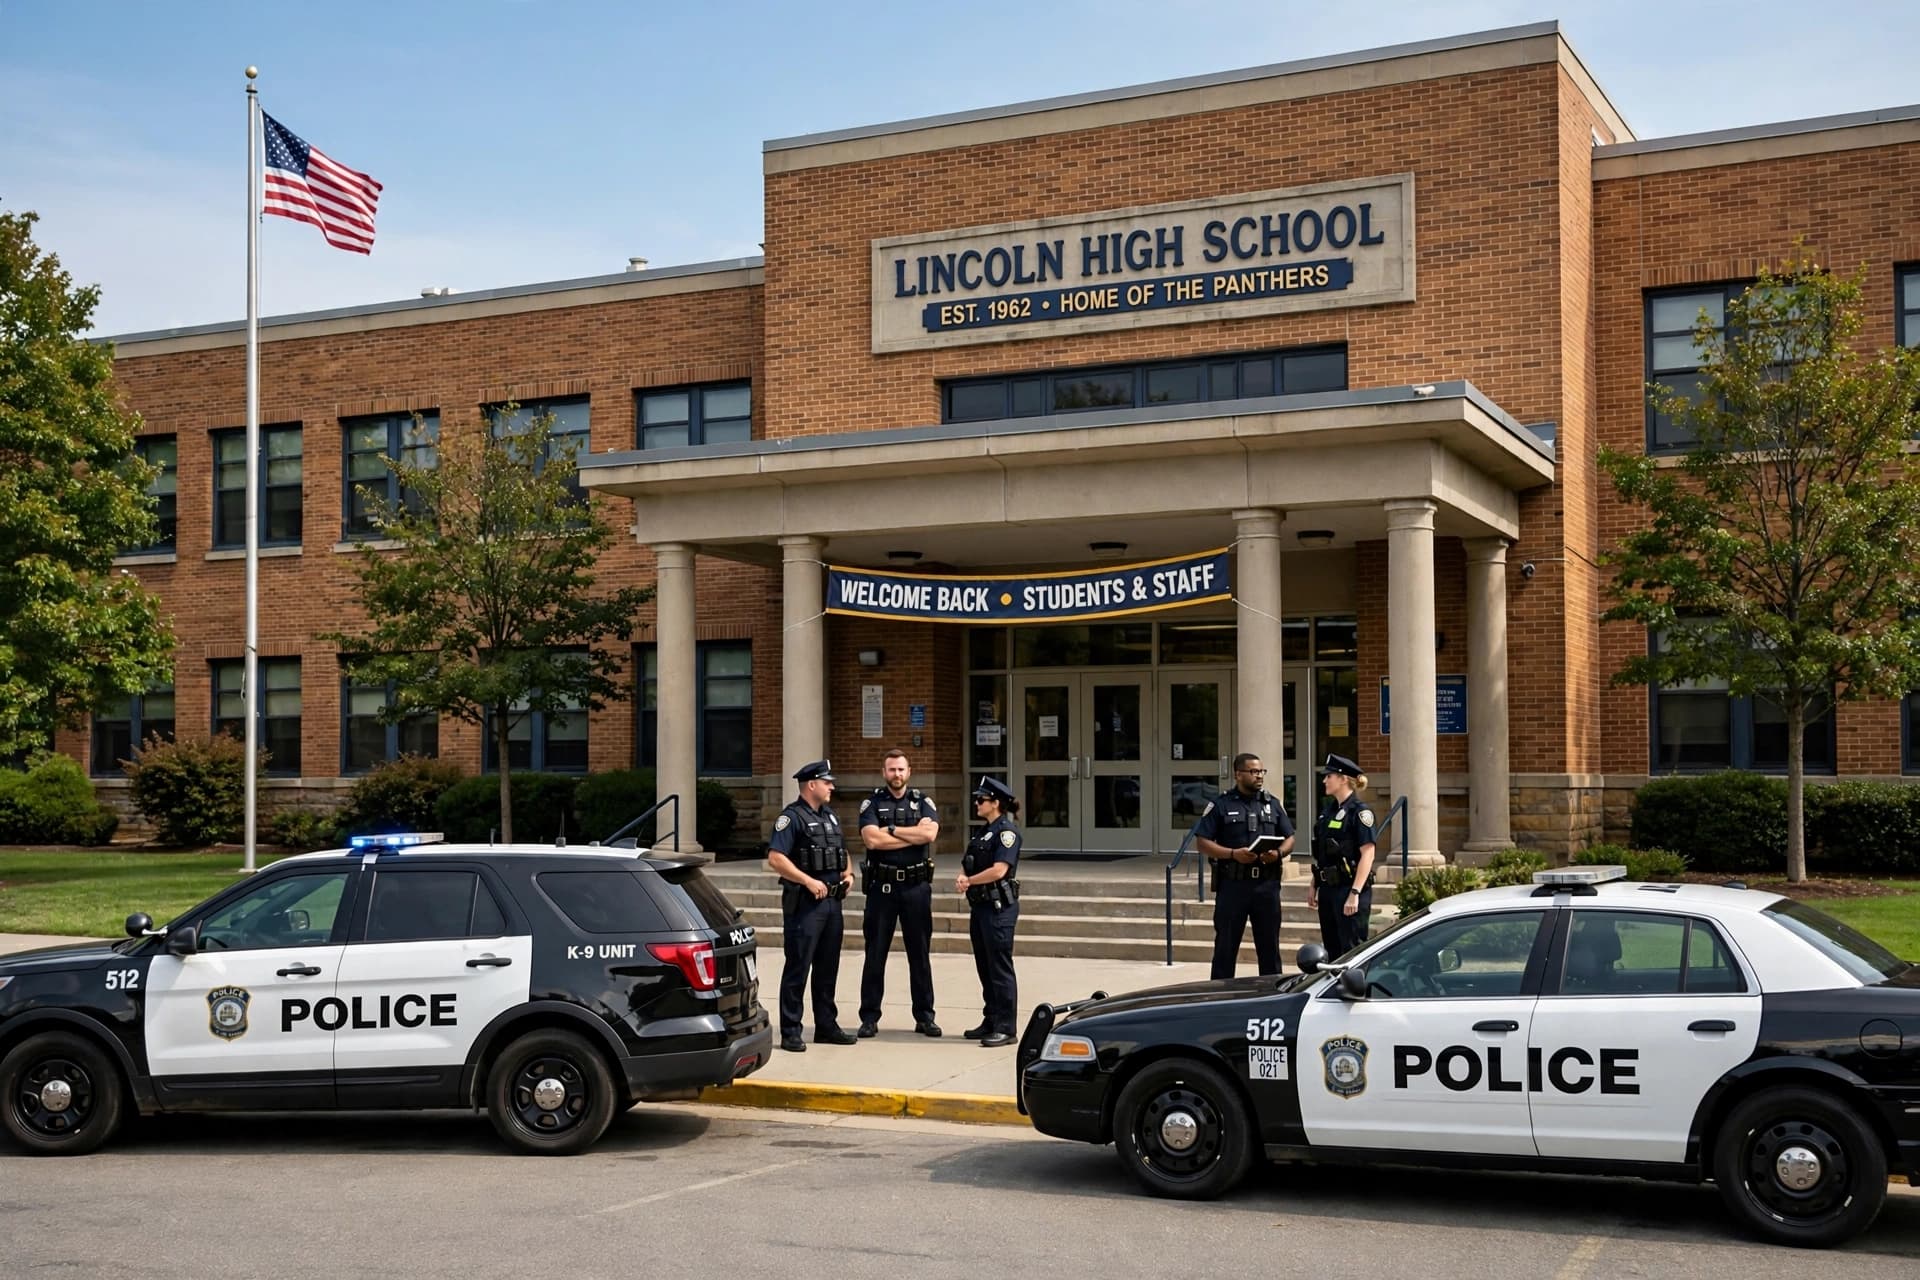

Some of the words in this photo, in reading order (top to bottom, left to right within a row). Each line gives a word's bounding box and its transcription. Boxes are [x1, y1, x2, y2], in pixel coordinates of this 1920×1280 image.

[894, 240, 1064, 298] LINCOLN
[1081, 224, 1184, 277] HIGH
[1203, 203, 1385, 263] SCHOOL
[940, 303, 981, 326] EST.
[988, 299, 1031, 320] 1962
[1060, 288, 1119, 313] HOME
[1126, 284, 1155, 306] OF
[1163, 278, 1204, 302] THE
[1213, 265, 1330, 297] PANTHERS
[841, 579, 931, 611] WELCOME
[937, 586, 989, 612] BACK
[1023, 578, 1126, 611] STUDENTS
[1131, 575, 1148, 601] &
[1152, 563, 1215, 598] STAFF
[567, 944, 595, 960] K-9
[599, 944, 637, 959] UNIT
[105, 969, 140, 990] 512
[281, 993, 458, 1033] POLICE
[1246, 1018, 1285, 1041] 512
[1250, 1047, 1286, 1063] POLICE
[1327, 1038, 1362, 1051] POLICE
[1259, 1063, 1278, 1078] 021
[1393, 1045, 1641, 1095] POLICE
